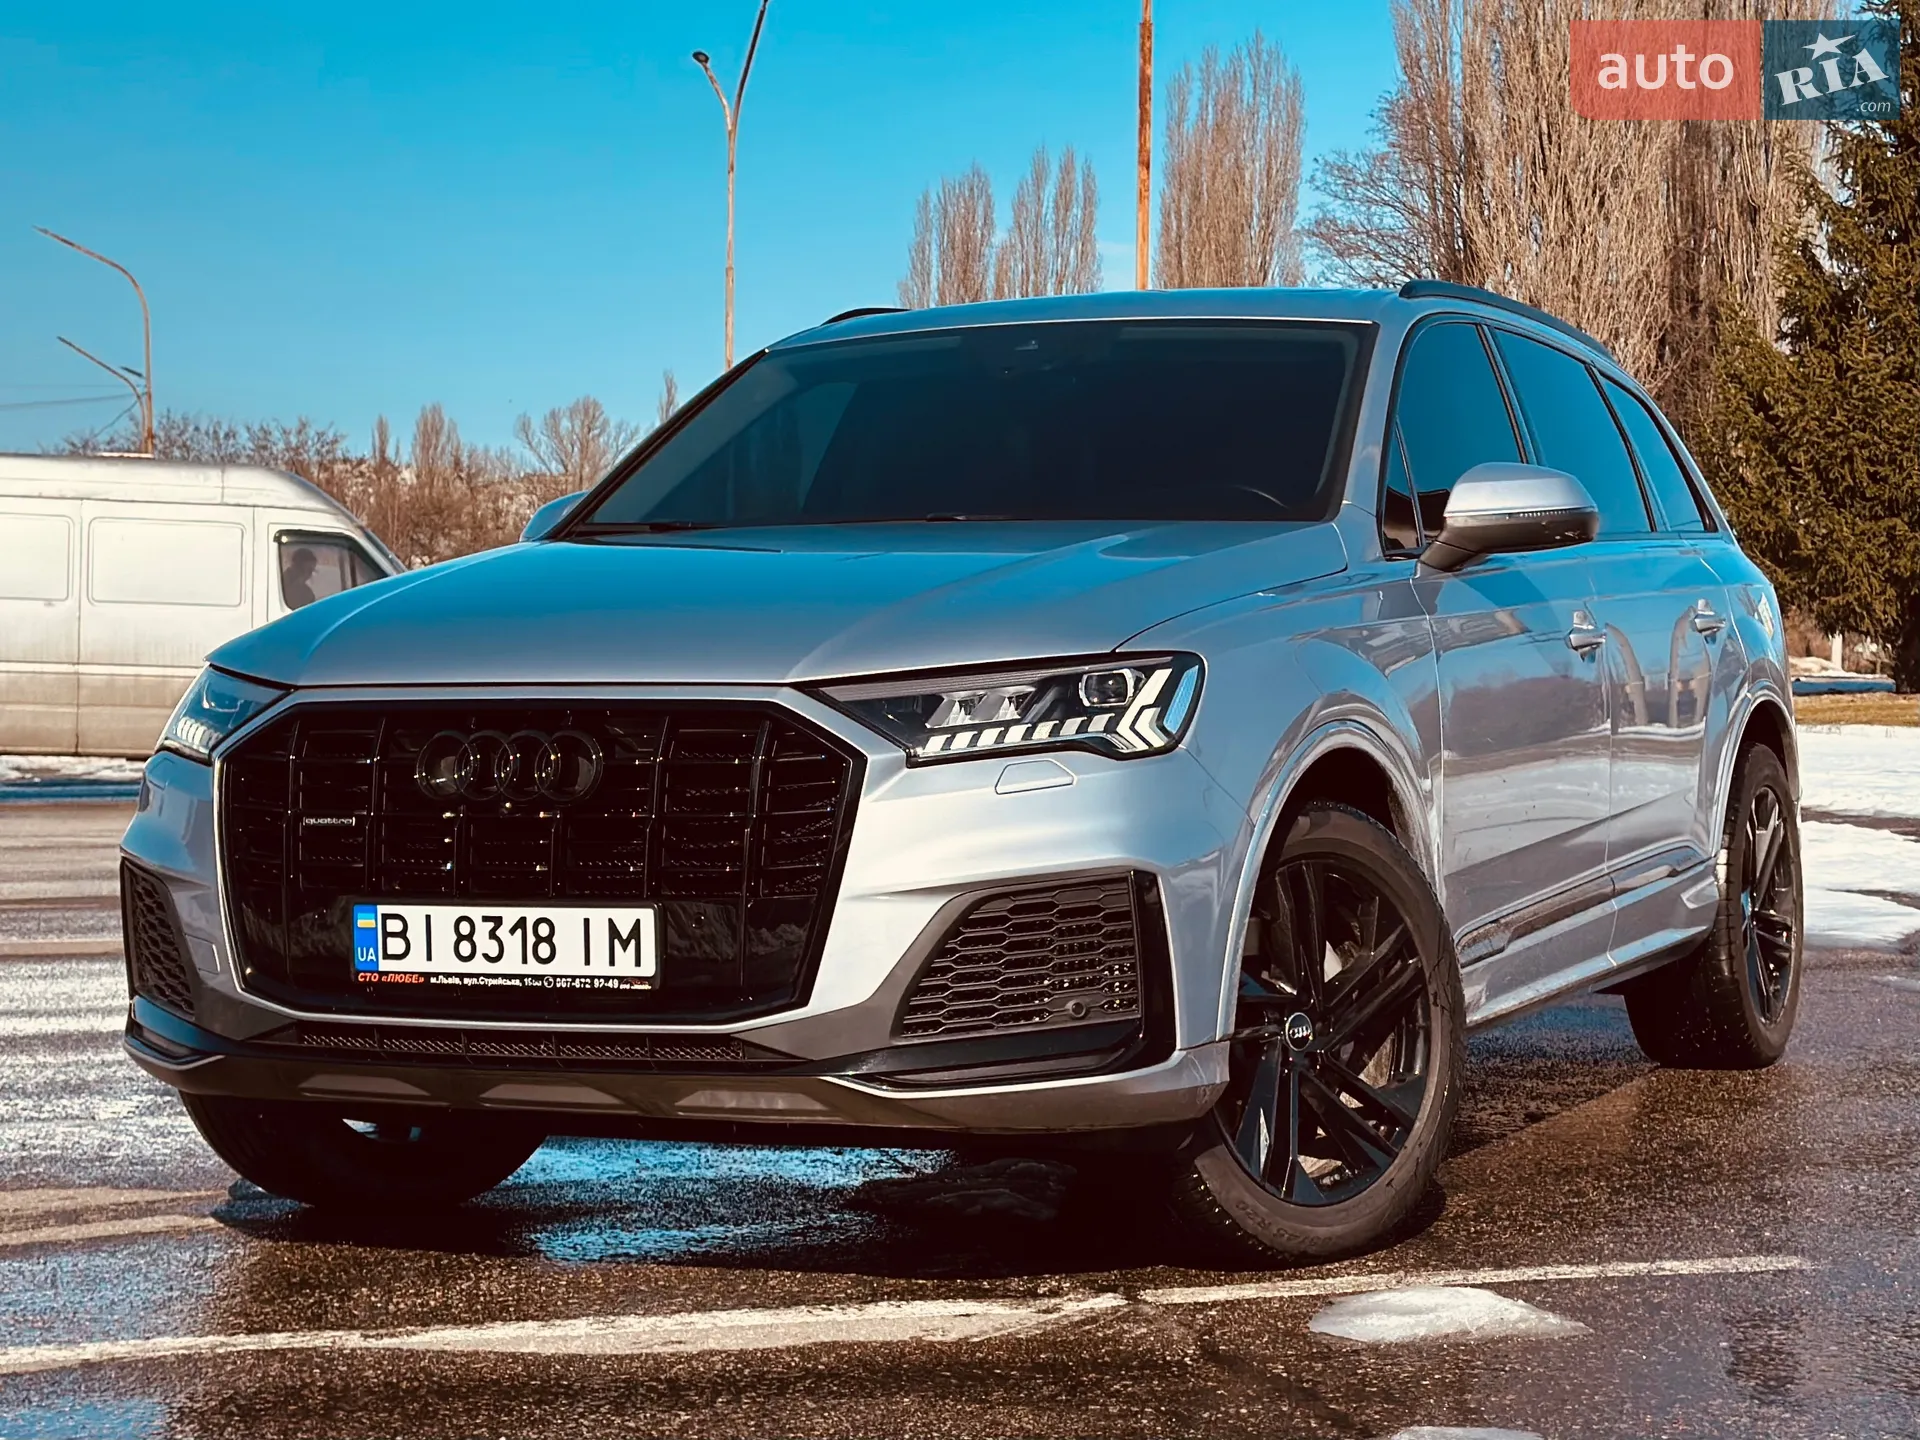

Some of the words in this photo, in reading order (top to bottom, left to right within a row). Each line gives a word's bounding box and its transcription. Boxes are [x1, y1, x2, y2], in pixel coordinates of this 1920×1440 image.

[381, 913, 433, 962] BI
[453, 915, 557, 965] 8318
[583, 917, 642, 968] IM
[357, 947, 377, 962] UA
[357, 973, 379, 982] СТО
